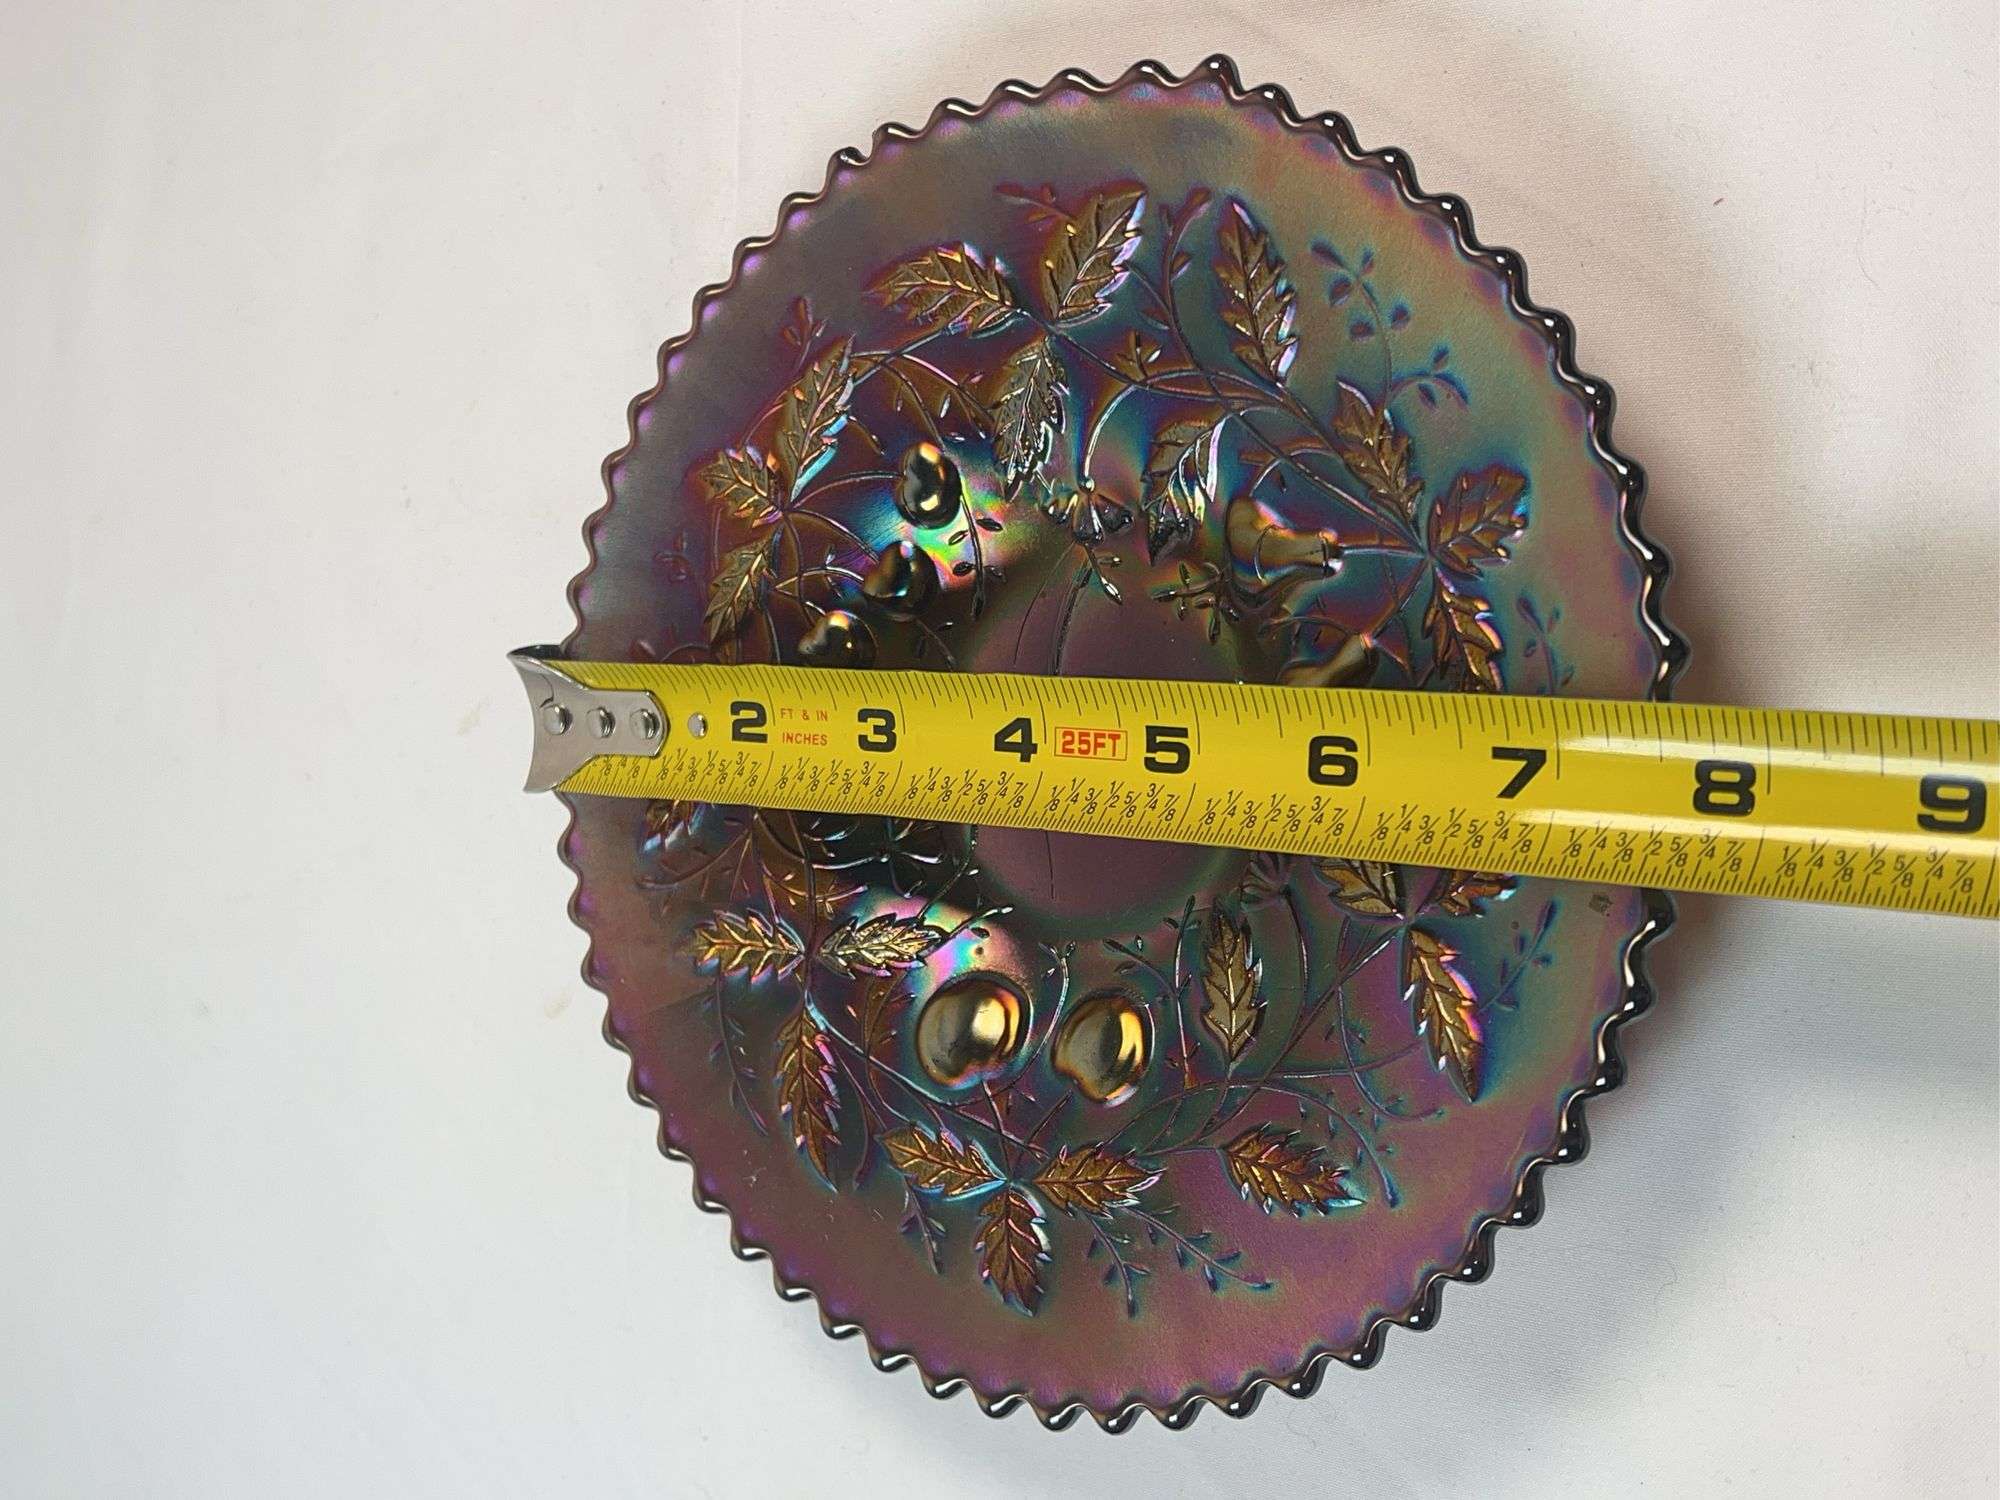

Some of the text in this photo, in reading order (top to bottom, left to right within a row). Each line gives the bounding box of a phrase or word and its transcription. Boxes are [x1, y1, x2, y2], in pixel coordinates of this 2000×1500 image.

[730, 700, 768, 744] 2
[780, 708, 828, 722] FT & IN
[857, 708, 897, 753] 3
[782, 732, 828, 746] INCHES
[994, 717, 1037, 763] 4
[1061, 730, 1122, 757] 25FT
[1144, 725, 1190, 775] 5
[1307, 735, 1359, 786] 6
[1491, 746, 1547, 799] 7
[1693, 759, 1757, 816] 8
[1916, 774, 1987, 833] 9
